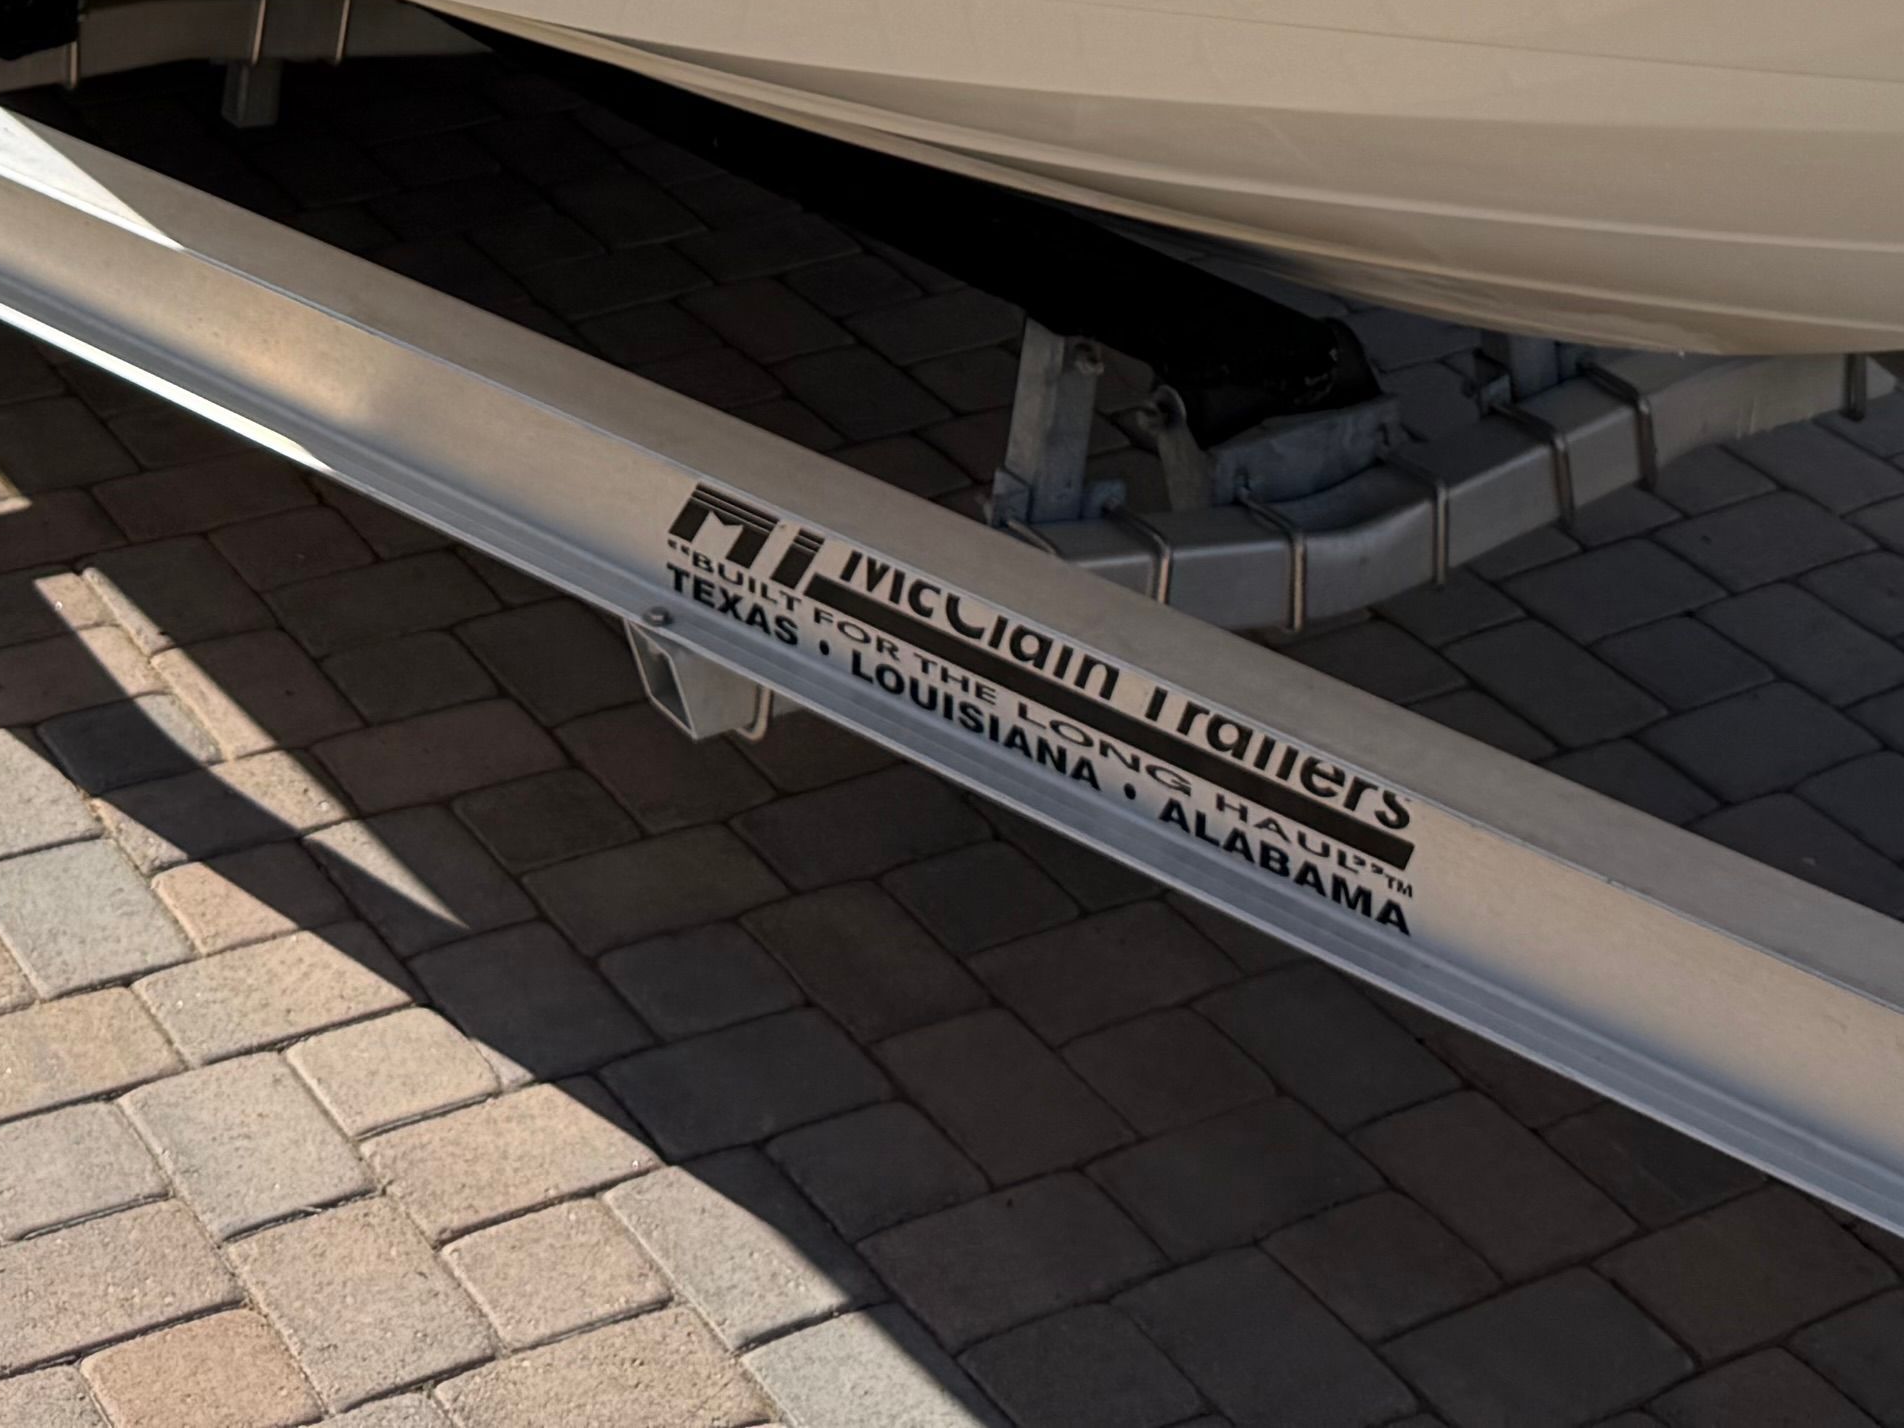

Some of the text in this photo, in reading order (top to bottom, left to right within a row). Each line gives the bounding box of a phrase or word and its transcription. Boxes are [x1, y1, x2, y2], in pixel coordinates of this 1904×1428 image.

[666, 563, 1411, 937] TEXAS LOUISIANA ALABAMA
[814, 607, 900, 661] FOR
[914, 652, 997, 706] THE
[1018, 702, 1192, 796] LONG
[839, 551, 1411, 830] McClain Trailers
